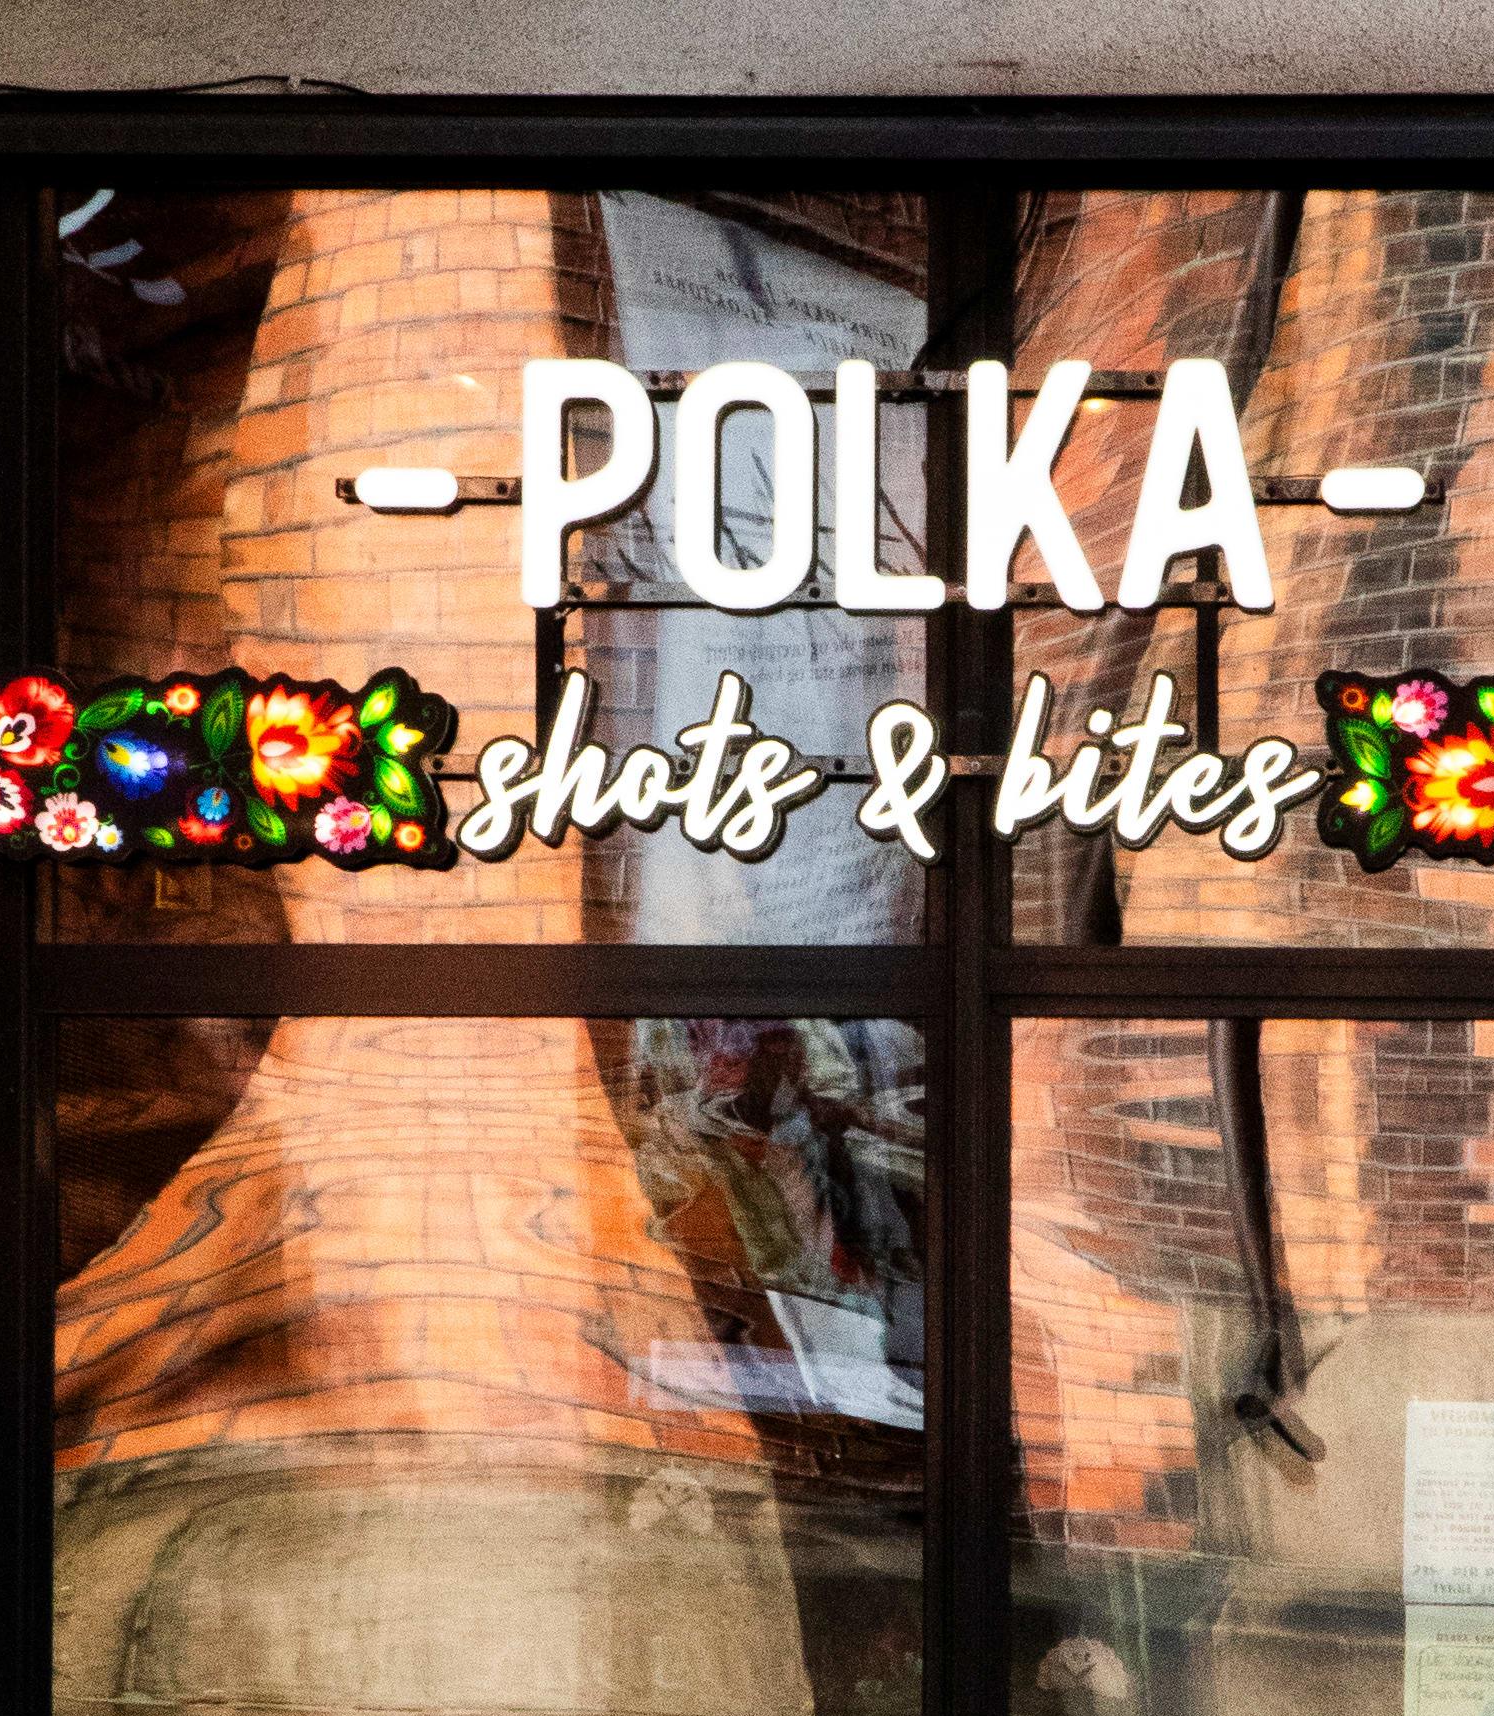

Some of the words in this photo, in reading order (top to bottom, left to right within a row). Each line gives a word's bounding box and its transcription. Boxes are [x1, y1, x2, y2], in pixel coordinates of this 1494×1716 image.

[520, 358, 1275, 614] POLKA
[457, 670, 821, 862] shots
[857, 698, 951, 866] &
[993, 670, 1327, 862] bites
